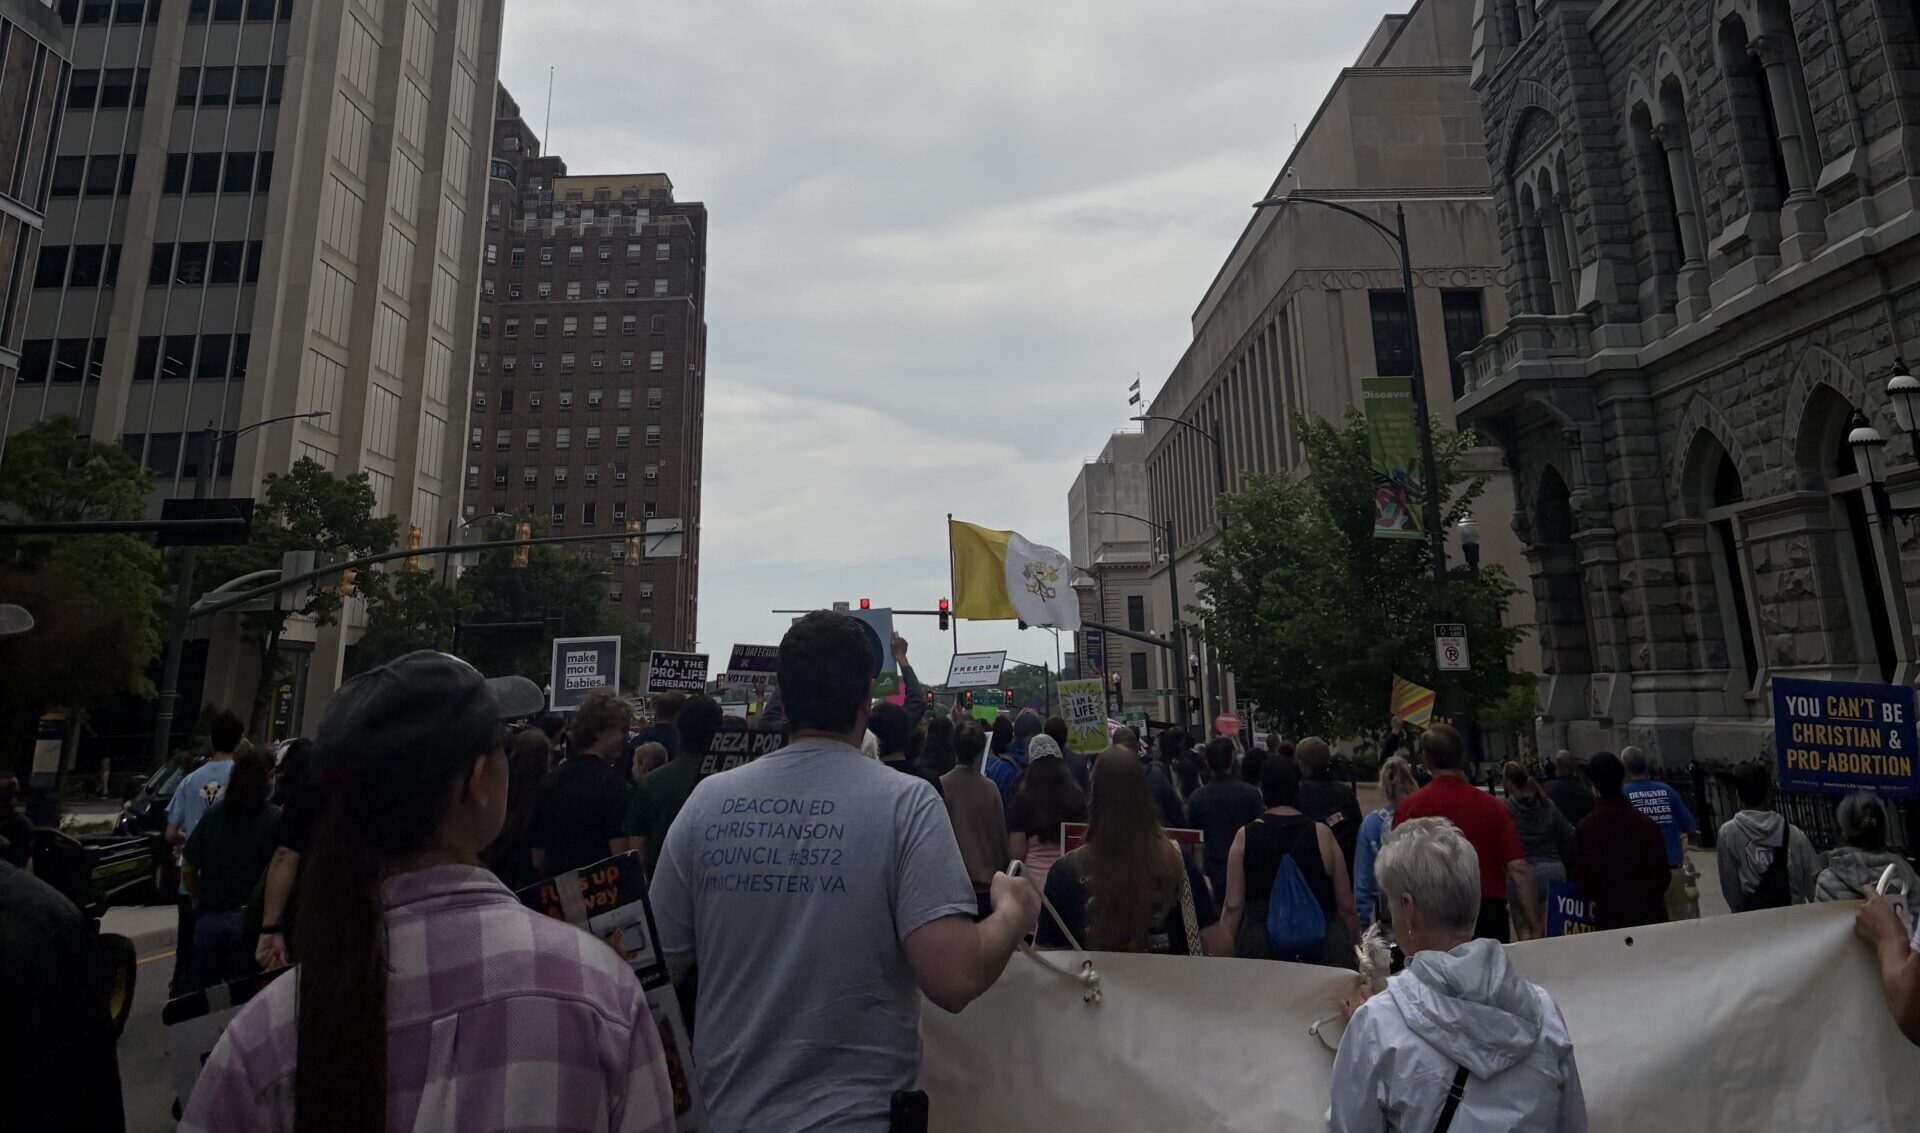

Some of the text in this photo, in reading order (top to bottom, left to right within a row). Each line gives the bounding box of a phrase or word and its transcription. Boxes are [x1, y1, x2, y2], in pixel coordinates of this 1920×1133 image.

[1363, 391, 1411, 400] Discover
[567, 652, 597, 663] make
[654, 658, 705, 669] I AM THE
[567, 664, 596, 674] more
[650, 667, 707, 681] PRO-LIFE
[953, 664, 1000, 672] FREEDOM
[566, 677, 606, 689] babies.
[650, 679, 706, 690] GENERATION
[728, 674, 752, 683] VOTE
[1073, 704, 1096, 718] LIFE
[1785, 695, 1904, 724] YOU CAN'T BE
[709, 732, 783, 752] REZA POR
[1791, 722, 1903, 750] CHRISTIAN &
[700, 754, 722, 774] EL
[1786, 748, 1912, 777] PRO-ABORTION
[1629, 790, 1668, 799] DESIGNED
[722, 798, 835, 816] DEACON ED
[1637, 805, 1673, 814] ERVICES
[705, 822, 845, 842] CHRISTIANSON
[700, 847, 843, 867] COUNCIL #3572
[820, 875, 847, 893] VA
[1557, 895, 1584, 918] YOU
